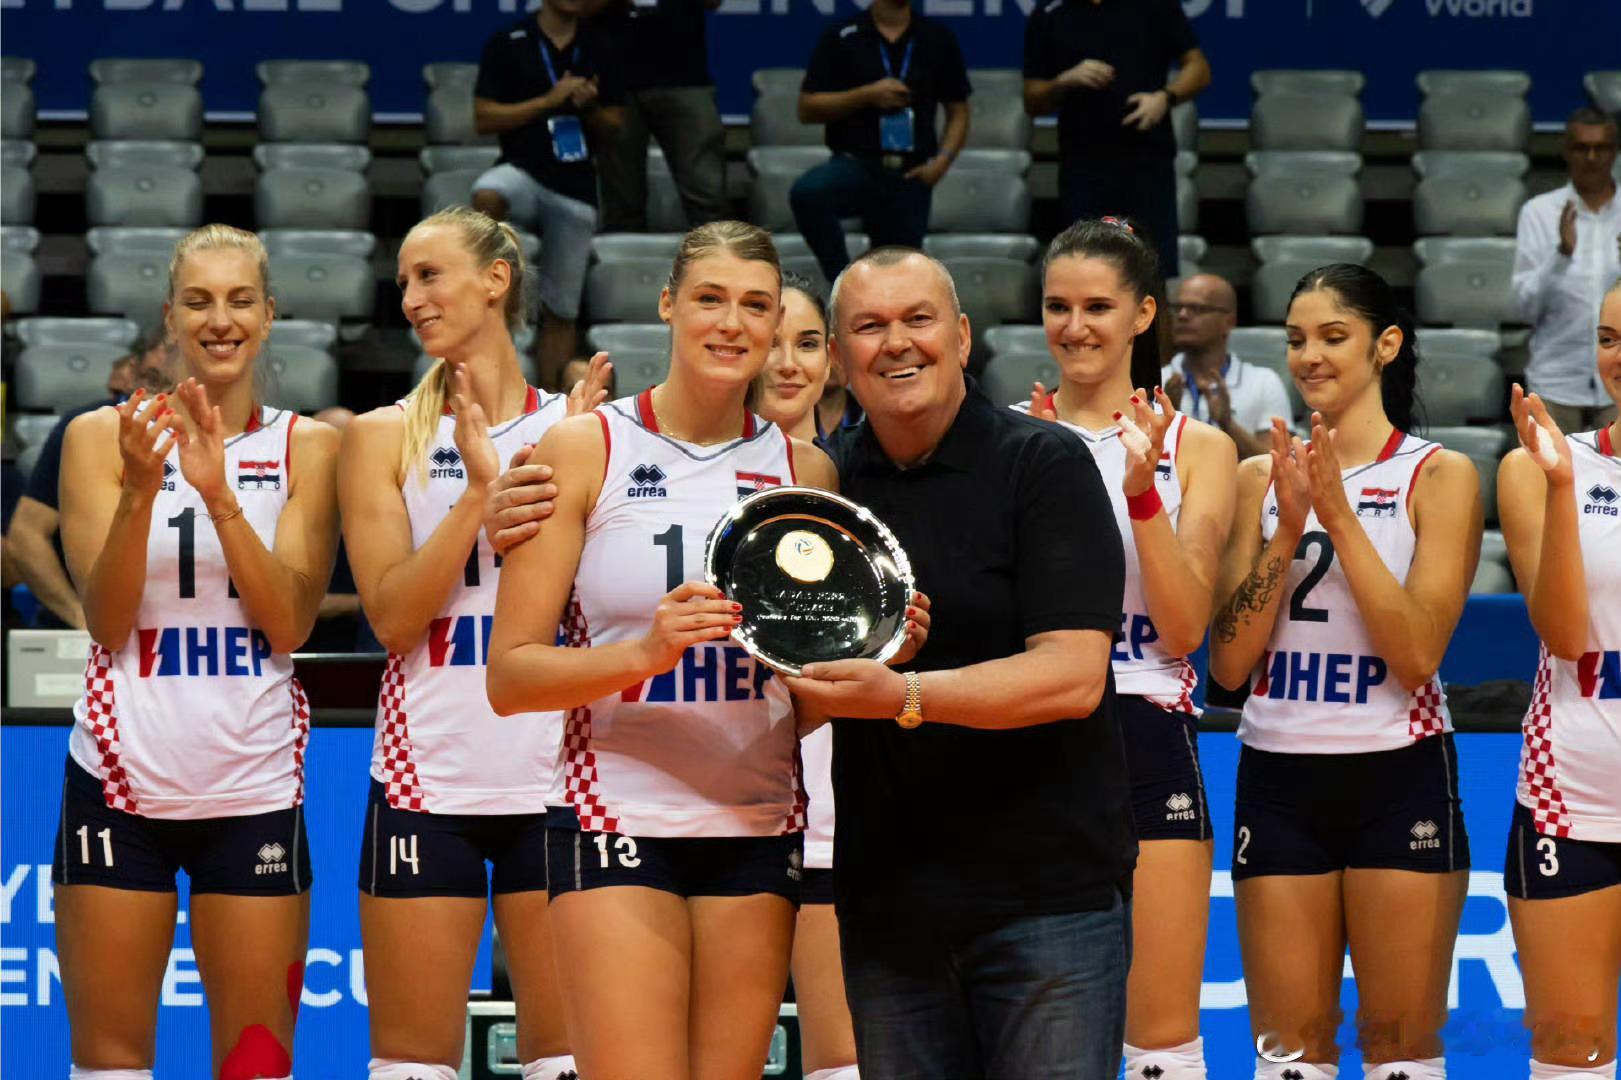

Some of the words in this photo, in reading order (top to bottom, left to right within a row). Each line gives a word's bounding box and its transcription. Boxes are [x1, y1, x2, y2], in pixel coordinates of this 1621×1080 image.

[430, 467, 464, 479] errea
[627, 486, 667, 497] errea
[1584, 503, 1618, 516] errea
[1289, 531, 1335, 623] 2
[186, 627, 272, 676] HEP
[1287, 651, 1388, 704] HEP
[76, 825, 114, 867] 11
[389, 834, 420, 876] 14
[1236, 826, 1251, 865] 2
[1535, 837, 1560, 877] 3
